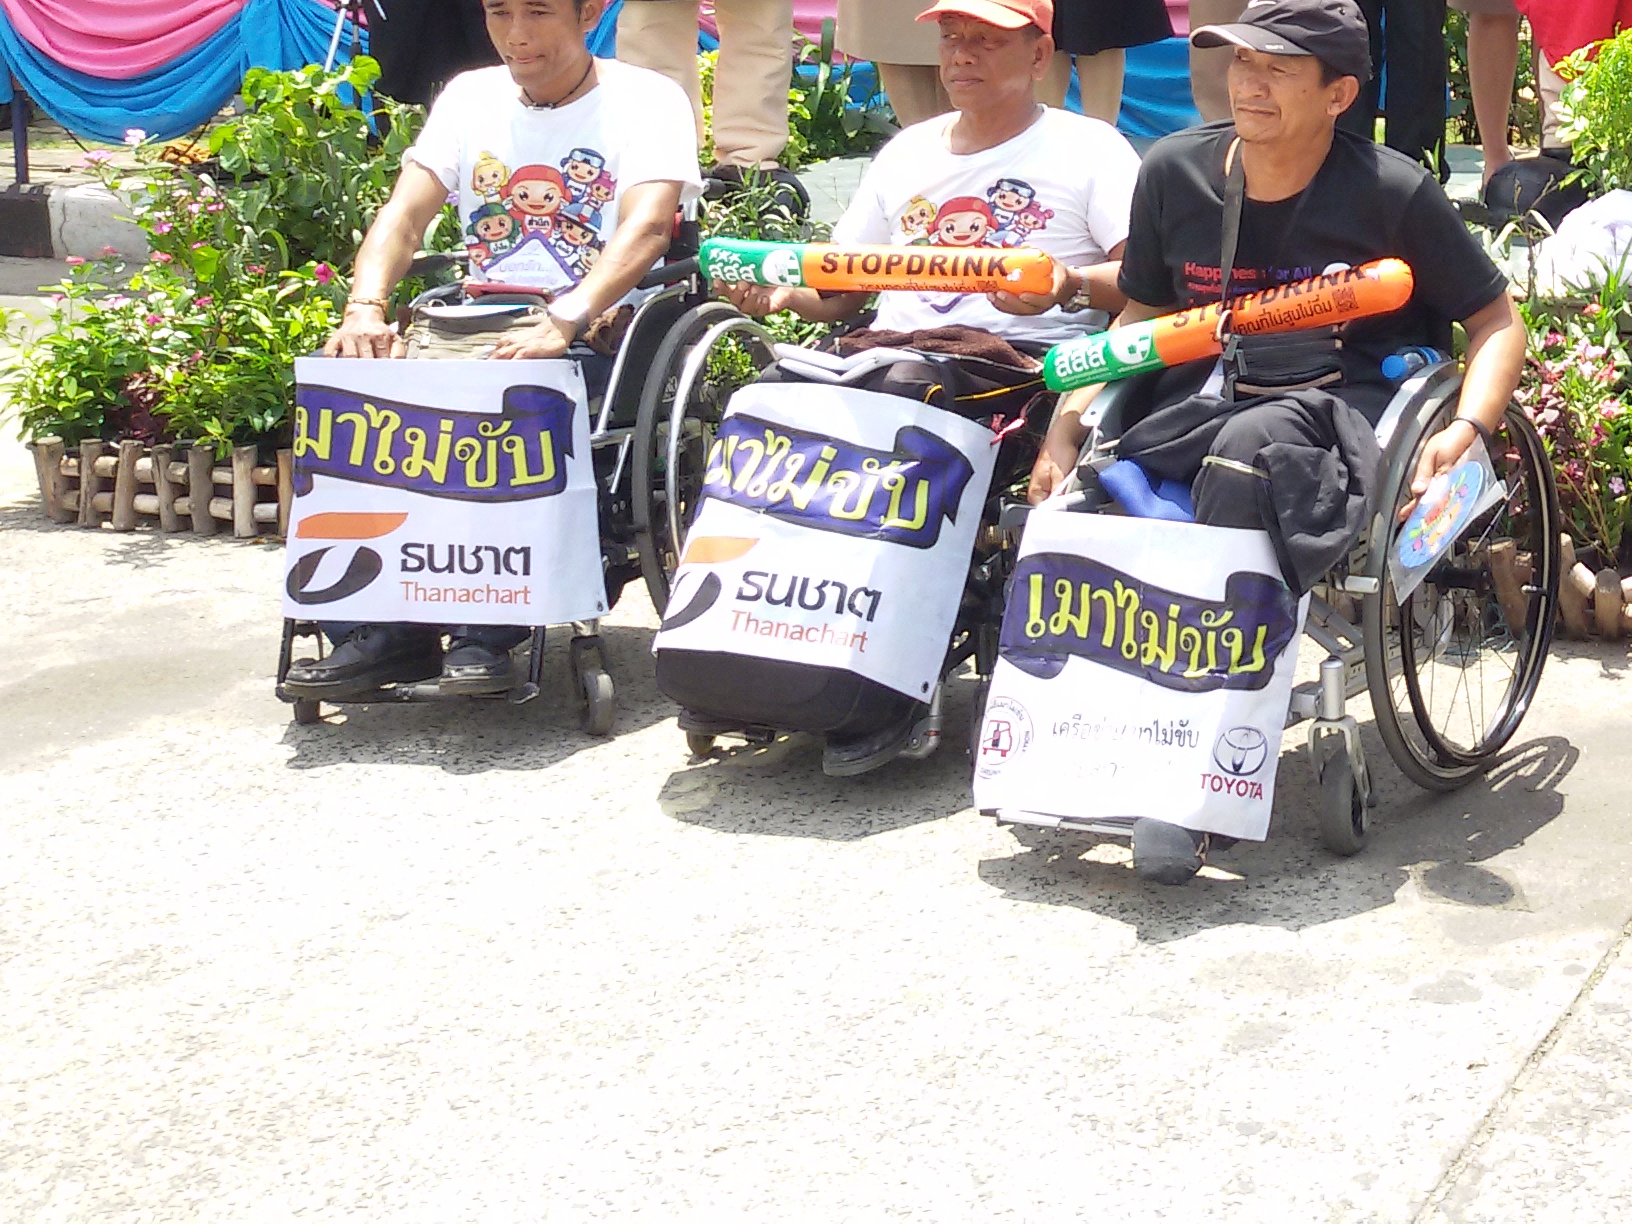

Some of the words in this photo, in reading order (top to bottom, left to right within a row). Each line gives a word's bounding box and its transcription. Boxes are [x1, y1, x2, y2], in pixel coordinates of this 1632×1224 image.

[820, 251, 1010, 278] STOPDRINK
[400, 542, 531, 576] ธนชาต
[400, 581, 531, 605] Thanachart
[735, 570, 882, 623] ธนชาต
[730, 609, 868, 653] Thanachart
[1025, 573, 1268, 678] เมาไม่ขับ
[1200, 772, 1264, 800] TOYOTA
